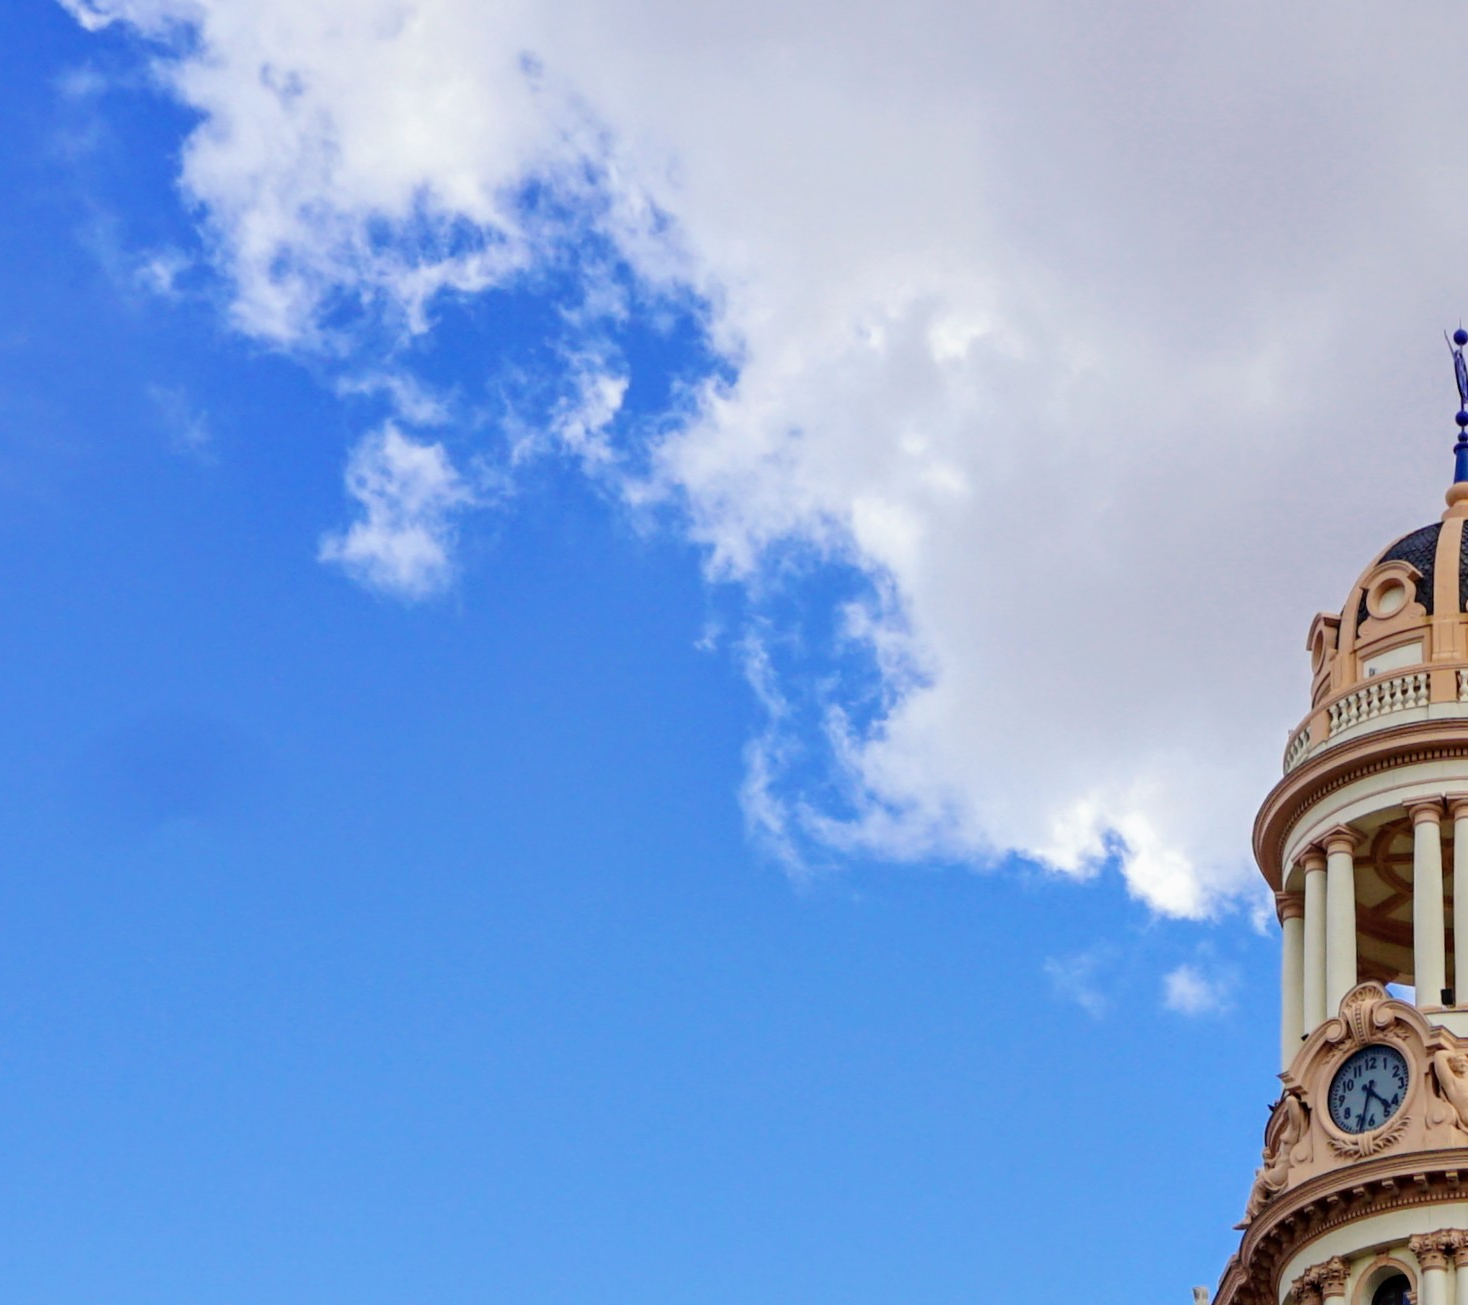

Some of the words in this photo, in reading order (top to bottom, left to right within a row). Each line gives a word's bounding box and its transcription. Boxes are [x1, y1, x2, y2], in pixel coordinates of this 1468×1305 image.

[1365, 1057, 1377, 1071] 12
[1353, 1065, 1363, 1079] 11
[1392, 1065, 1400, 1078] 2
[1343, 1079, 1354, 1093] 10
[1368, 1113, 1376, 1127] 6
